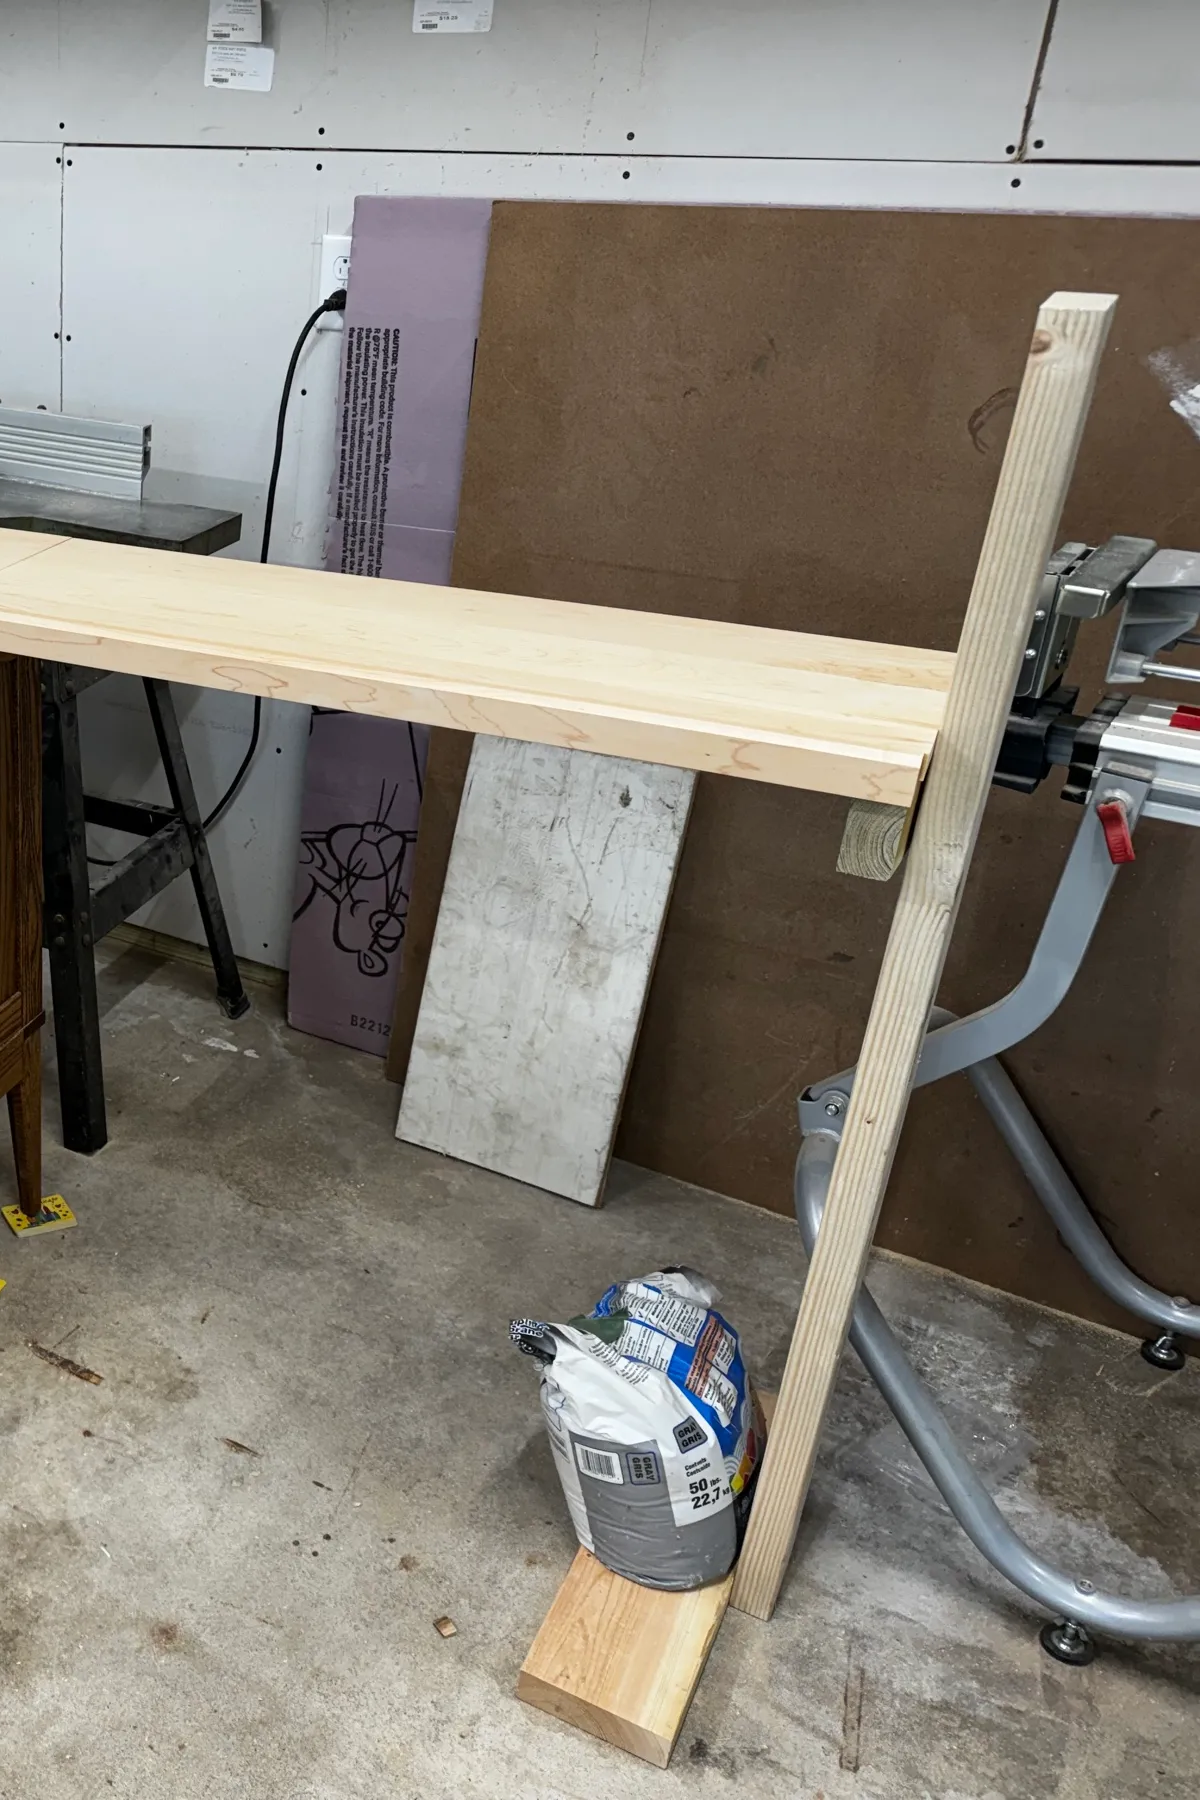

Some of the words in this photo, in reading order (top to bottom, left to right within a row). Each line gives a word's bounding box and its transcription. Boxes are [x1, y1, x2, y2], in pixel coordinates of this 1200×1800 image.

[355, 327, 363, 350] Follow
[364, 328, 372, 339] the
[390, 328, 400, 365] CAUTION:
[346, 340, 354, 369] material
[361, 341, 371, 375] insulating
[380, 328, 391, 369] appropriate
[378, 370, 388, 399] building
[389, 367, 397, 382] This
[350, 365, 361, 417] manufacturer's
[359, 377, 367, 400] power.
[386, 384, 396, 411] product
[366, 382, 376, 426] temperature.
[378, 401, 386, 420] code.
[341, 406, 349, 432] request
[348, 419, 357, 459] instructions
[357, 418, 365, 452] insulation
[383, 420, 393, 465] combustible.
[338, 462, 347, 484] review
[355, 472, 361, 480] be
[372, 453, 382, 493] information,
[353, 482, 361, 510] installed
[361, 476, 369, 512] resistance
[379, 473, 388, 506] protective
[341, 504, 351, 553] manufacturer's
[350, 511, 359, 538] properly
[369, 536, 374, 544] or
[375, 540, 383, 565] thermal
[350, 1014, 391, 1037] B2212
[682, 1432, 702, 1448] GRIS
[632, 1457, 644, 1479] GRIS
[643, 1456, 656, 1481] GRAY
[684, 1457, 707, 1471] Contents
[686, 1462, 711, 1477] Contenido
[689, 1478, 708, 1495] 50
[691, 1487, 721, 1510] 22,7
[722, 1486, 730, 1496] kg
